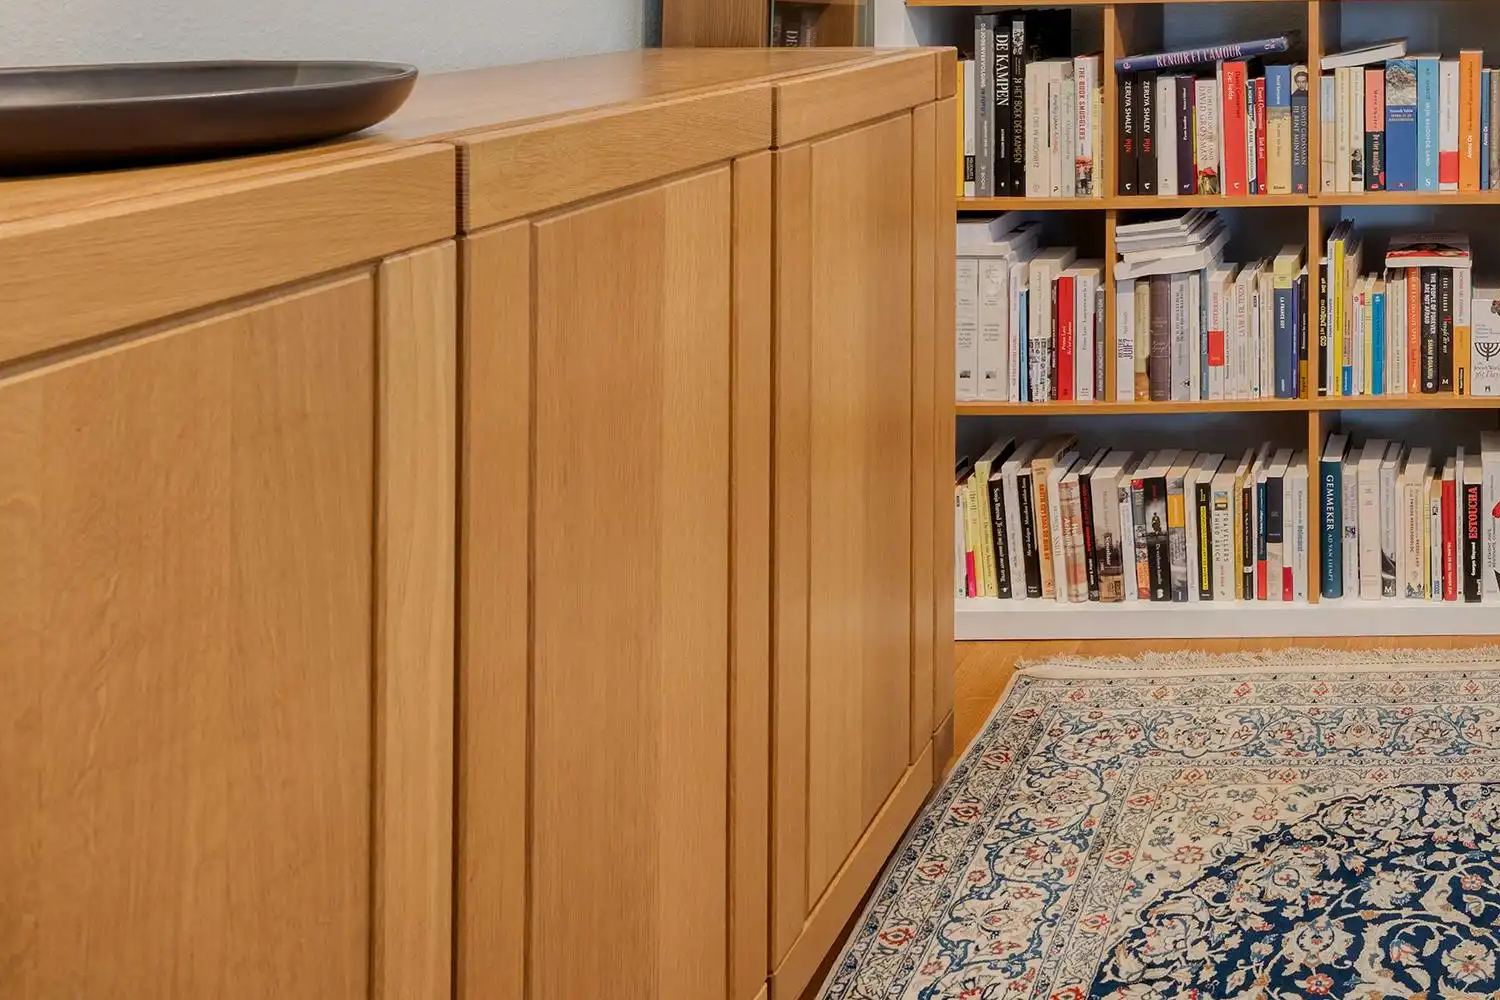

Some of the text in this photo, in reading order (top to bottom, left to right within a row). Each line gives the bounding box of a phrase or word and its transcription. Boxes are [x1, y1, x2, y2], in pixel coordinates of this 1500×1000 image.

[996, 34, 1009, 106] DE KAMPEN
[1013, 85, 1022, 163] HET BOEK DER KAMPEN
[1199, 86, 1207, 161] DAVID GROSSMAN
[1123, 339, 1133, 360] JUIF?
[1326, 474, 1334, 531] GEMMEKER
[1468, 487, 1477, 539] ESTOUCHA
[1328, 533, 1334, 543] AD
